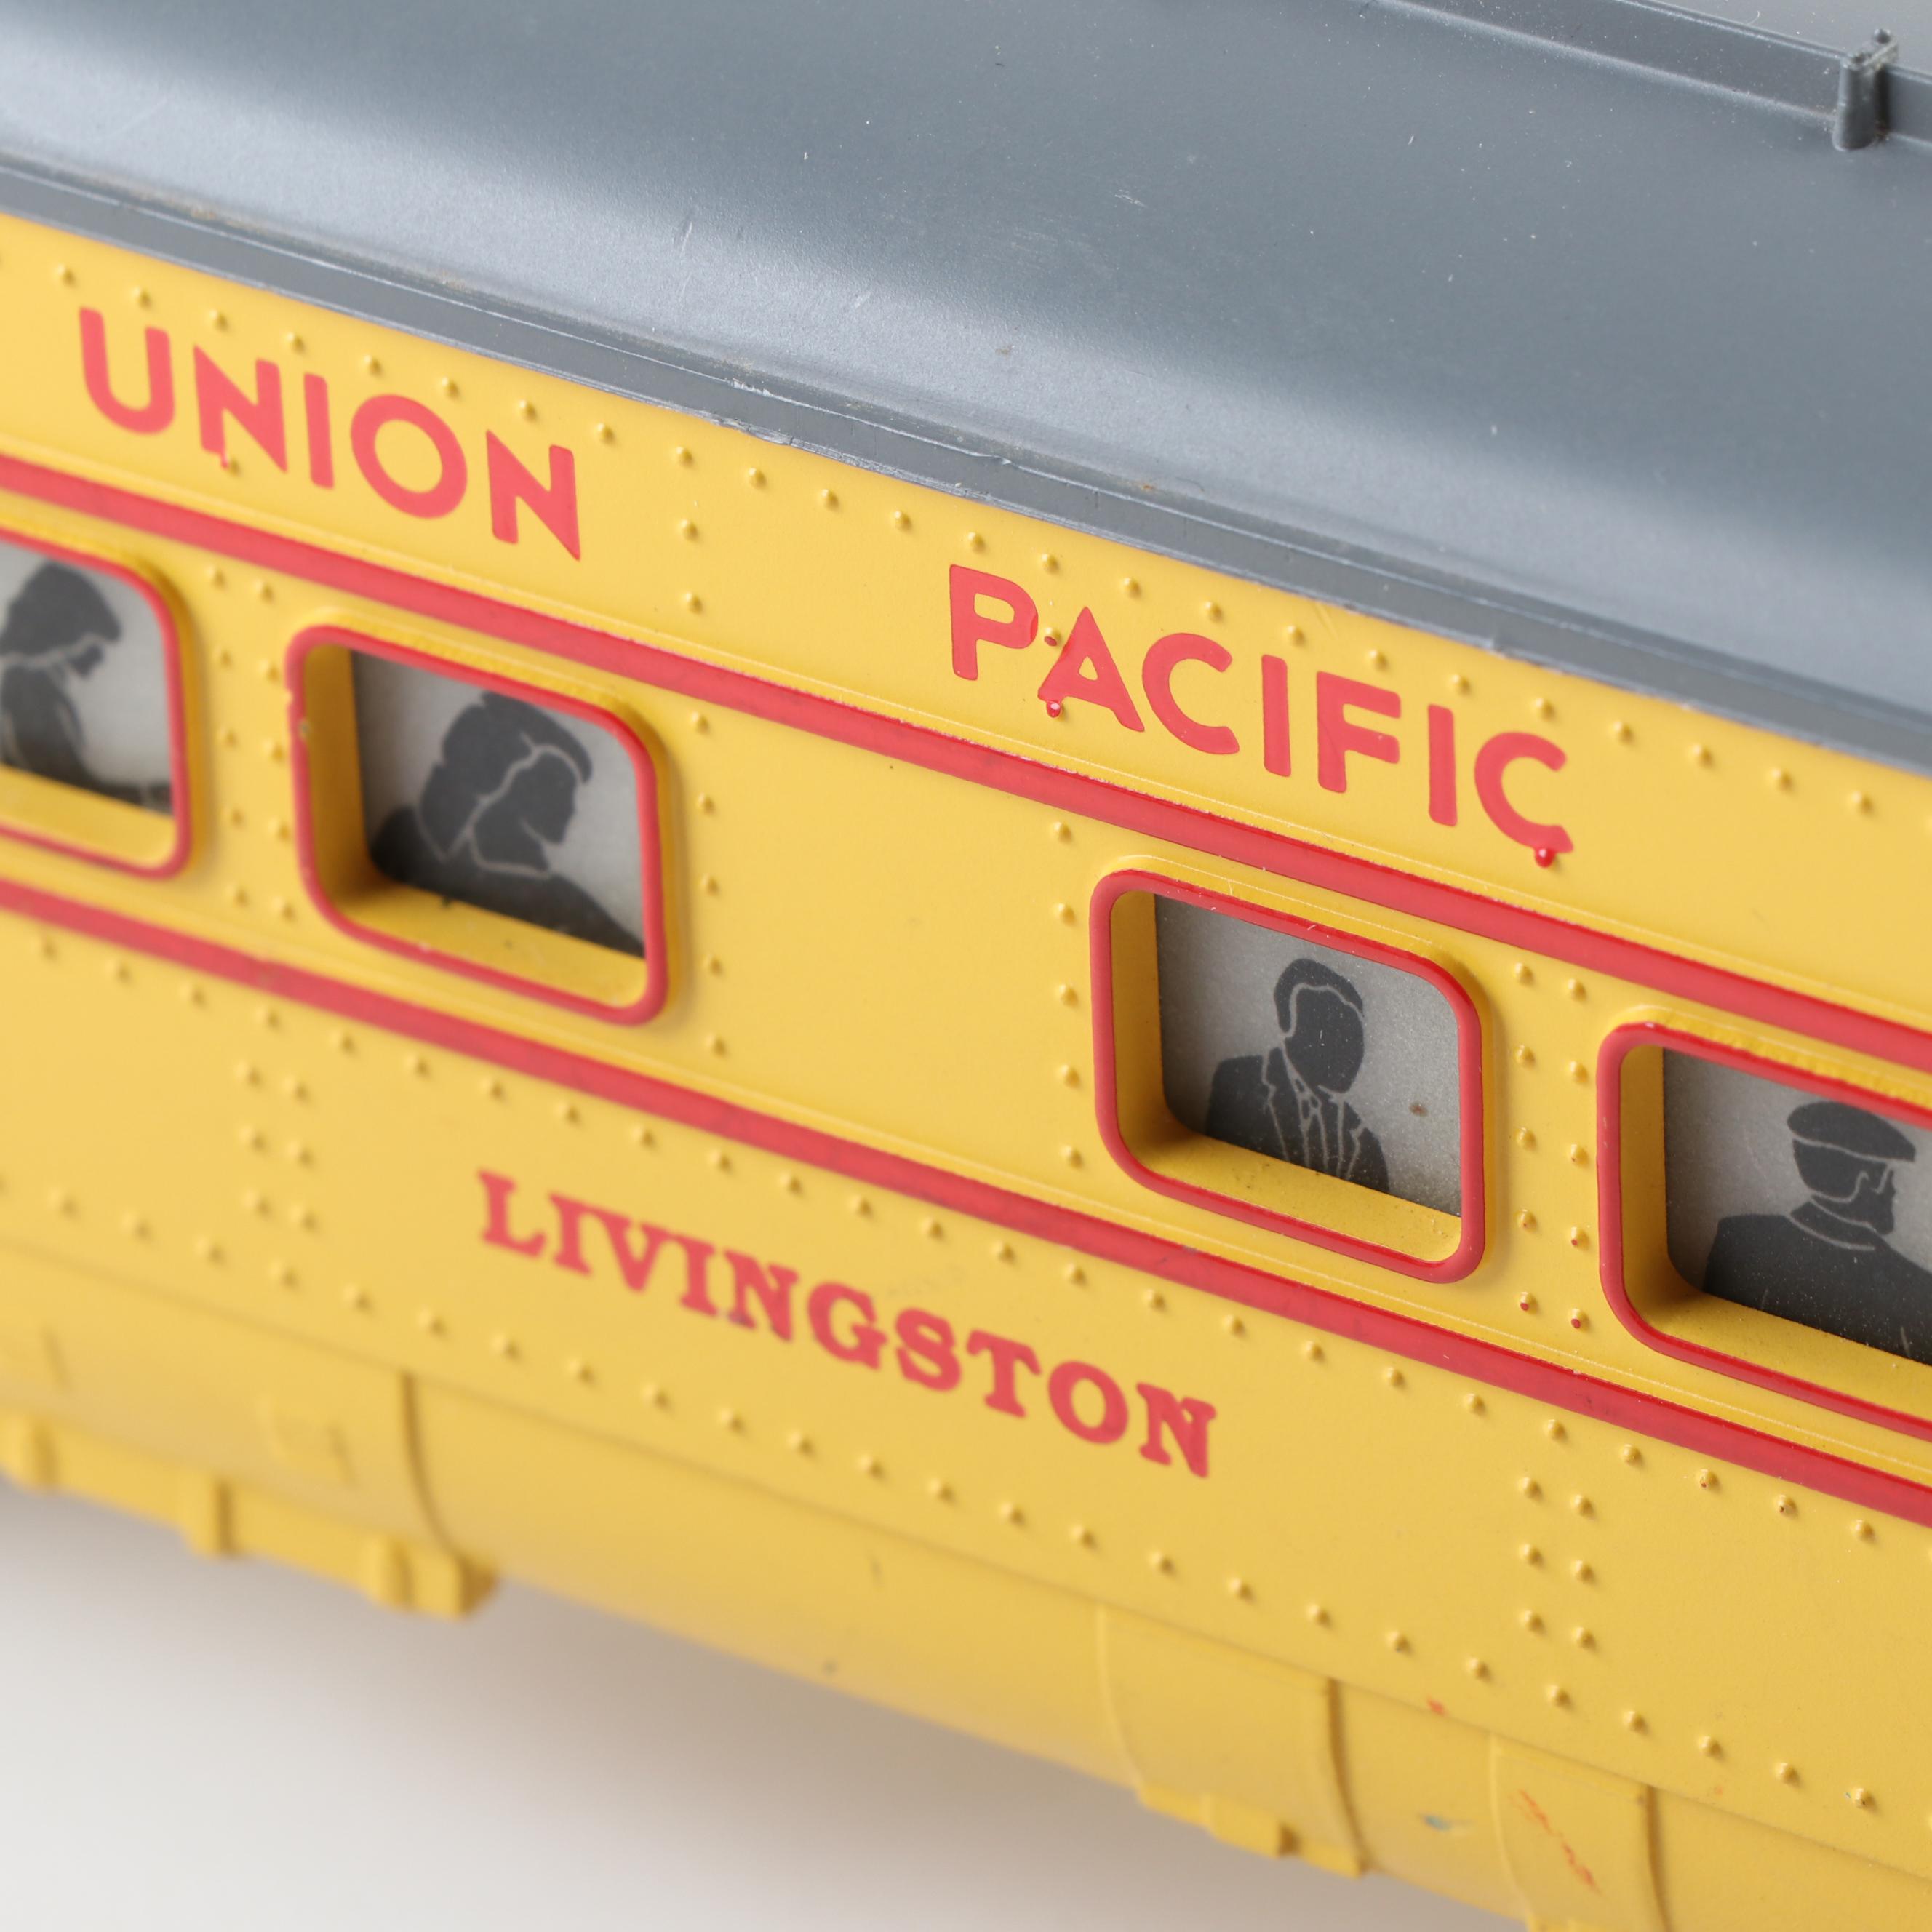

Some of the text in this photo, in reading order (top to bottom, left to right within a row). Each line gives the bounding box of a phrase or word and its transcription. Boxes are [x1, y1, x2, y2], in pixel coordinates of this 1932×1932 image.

[79, 308, 1575, 869] UNION PACIFIC
[479, 1170, 1217, 1478] LIVINGSTON
